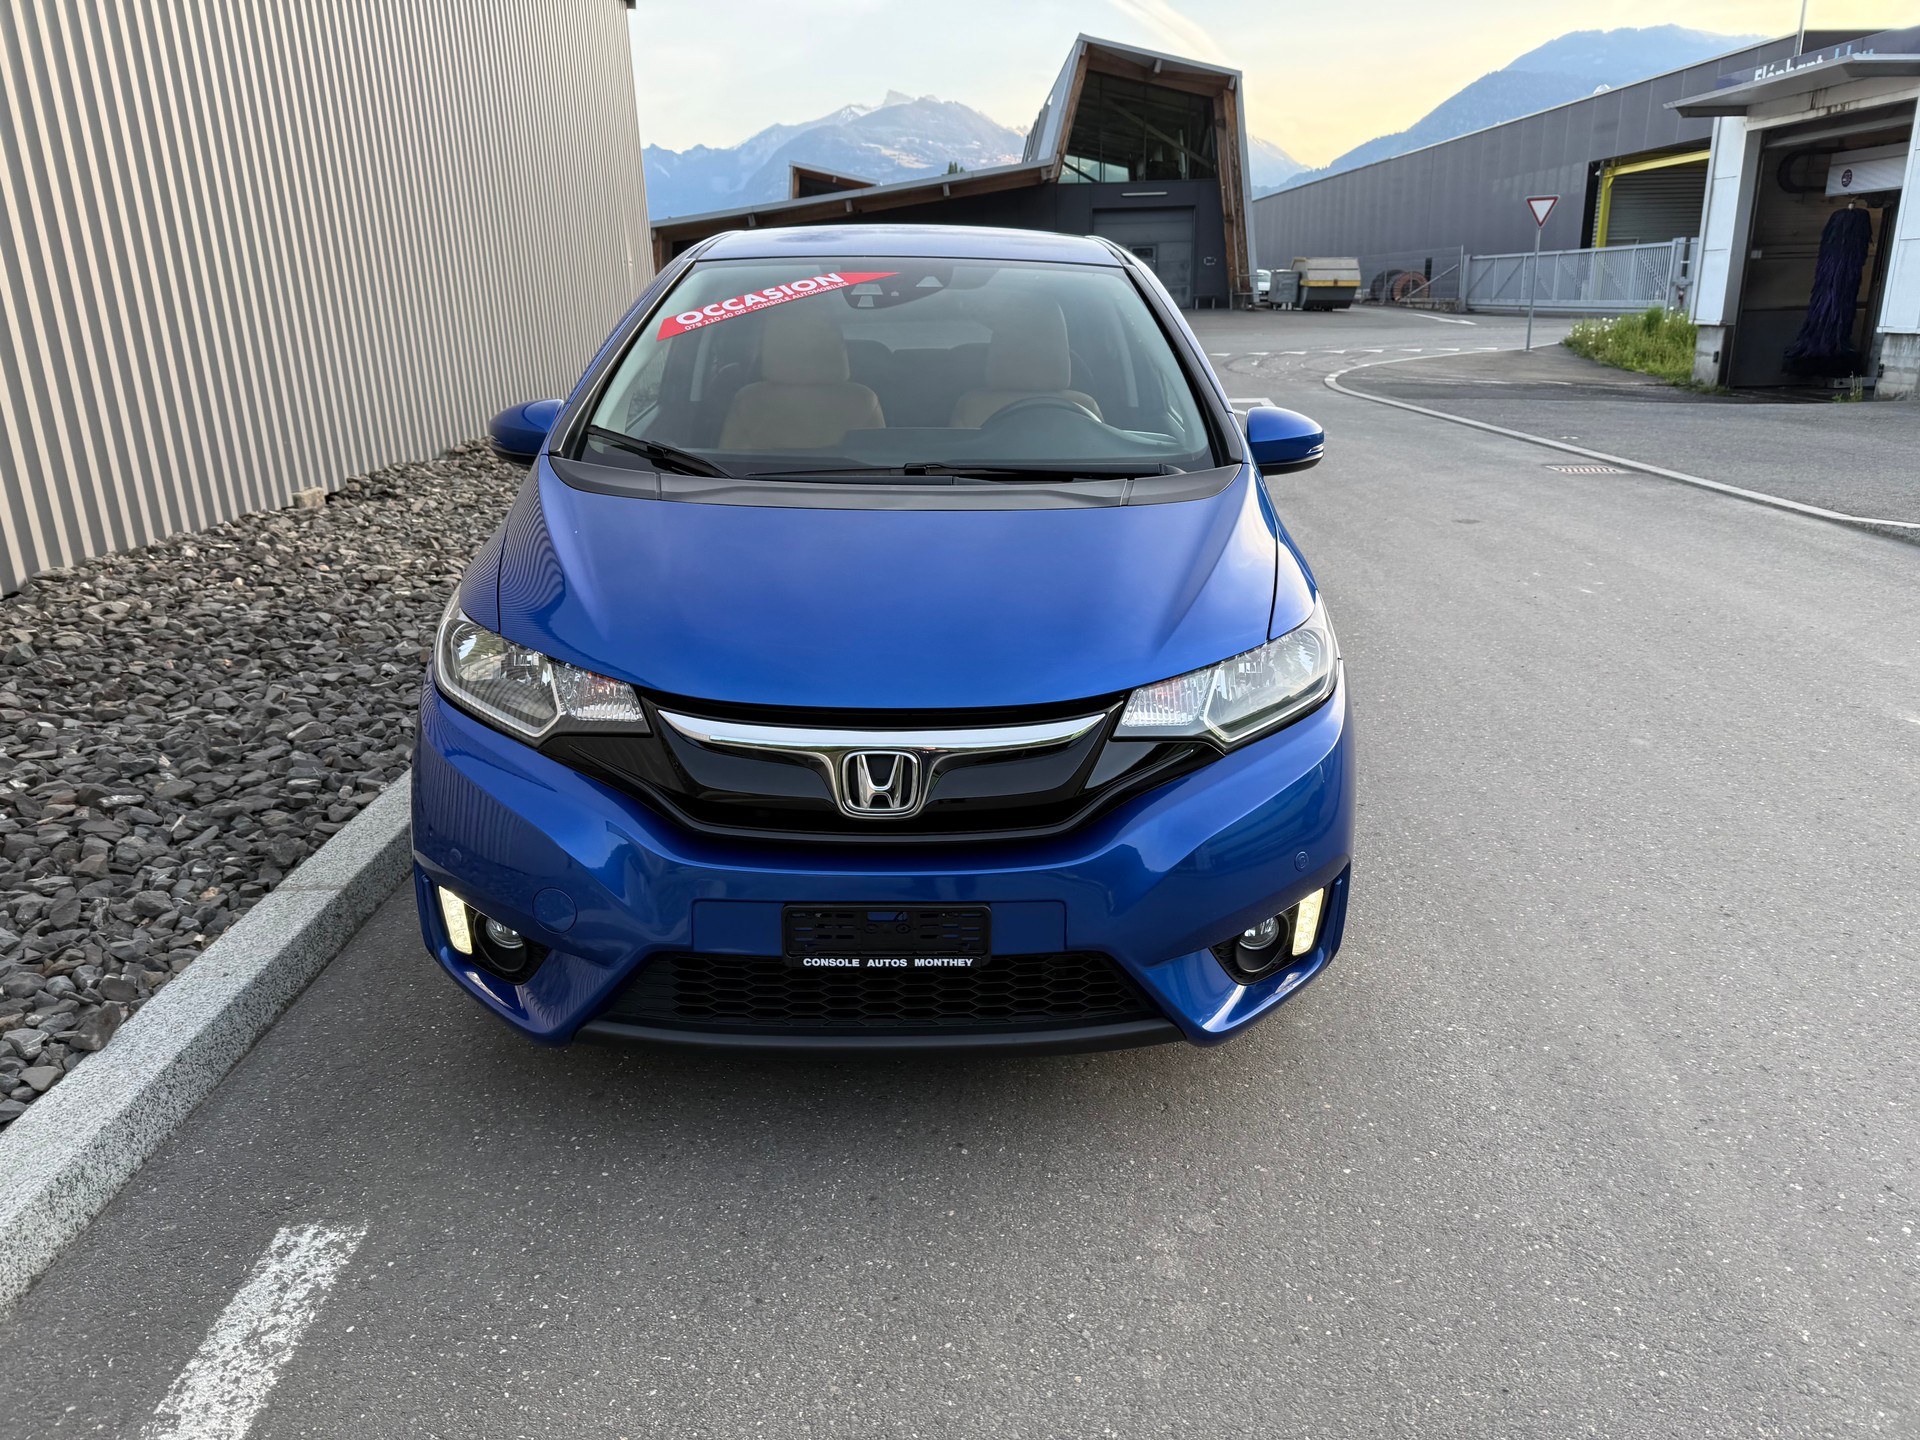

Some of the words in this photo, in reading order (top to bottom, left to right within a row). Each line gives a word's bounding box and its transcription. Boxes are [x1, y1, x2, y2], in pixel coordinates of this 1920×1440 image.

[676, 272, 845, 325] OCCASION
[685, 321, 703, 331] 079
[722, 312, 734, 320] 40
[752, 296, 792, 311] CONSOLE
[792, 281, 849, 299] AUTOMOBILES
[803, 957, 860, 967] CONSOLE
[867, 958, 908, 967] AUTOS
[914, 958, 973, 967] MONTHEY
